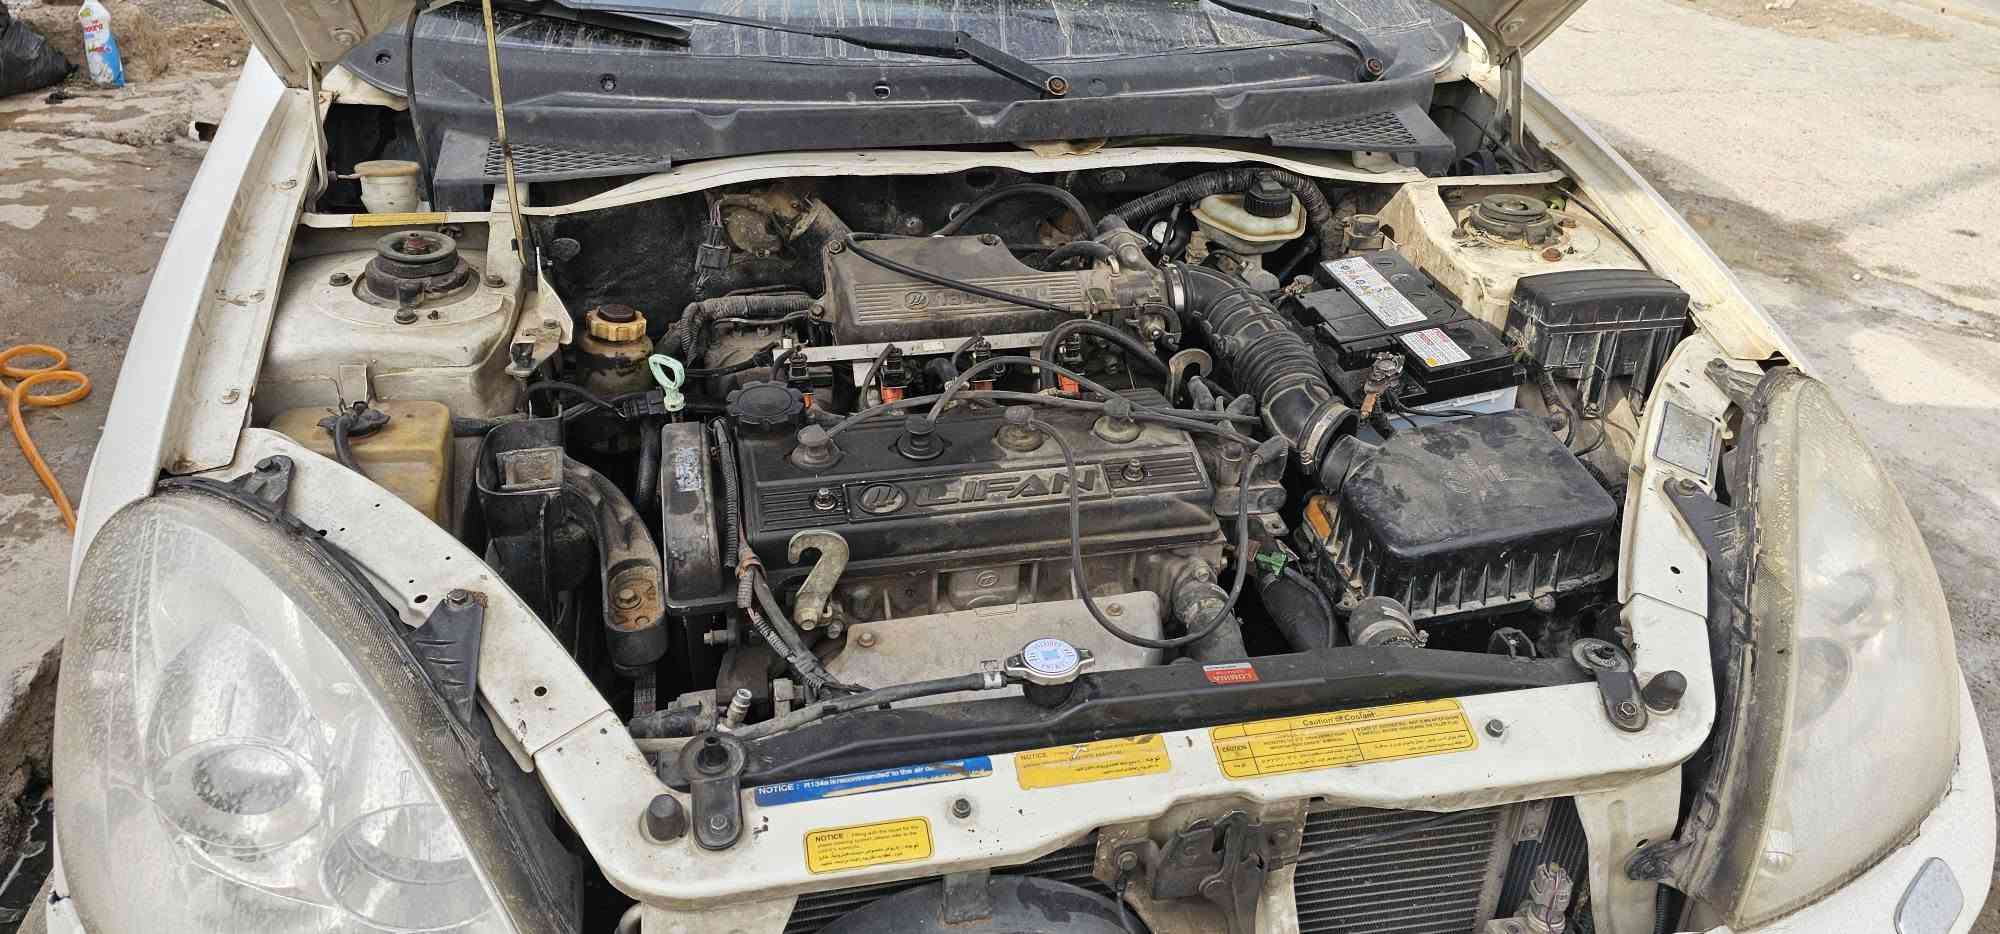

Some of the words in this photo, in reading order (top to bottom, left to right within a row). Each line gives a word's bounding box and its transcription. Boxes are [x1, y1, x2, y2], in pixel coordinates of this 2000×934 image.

[914, 469, 1097, 508] LIFAN
[1302, 718, 1334, 726] Caution
[1344, 711, 1376, 721] Coolant
[758, 783, 795, 795] NOTICE
[815, 833, 844, 843] NOTICE
